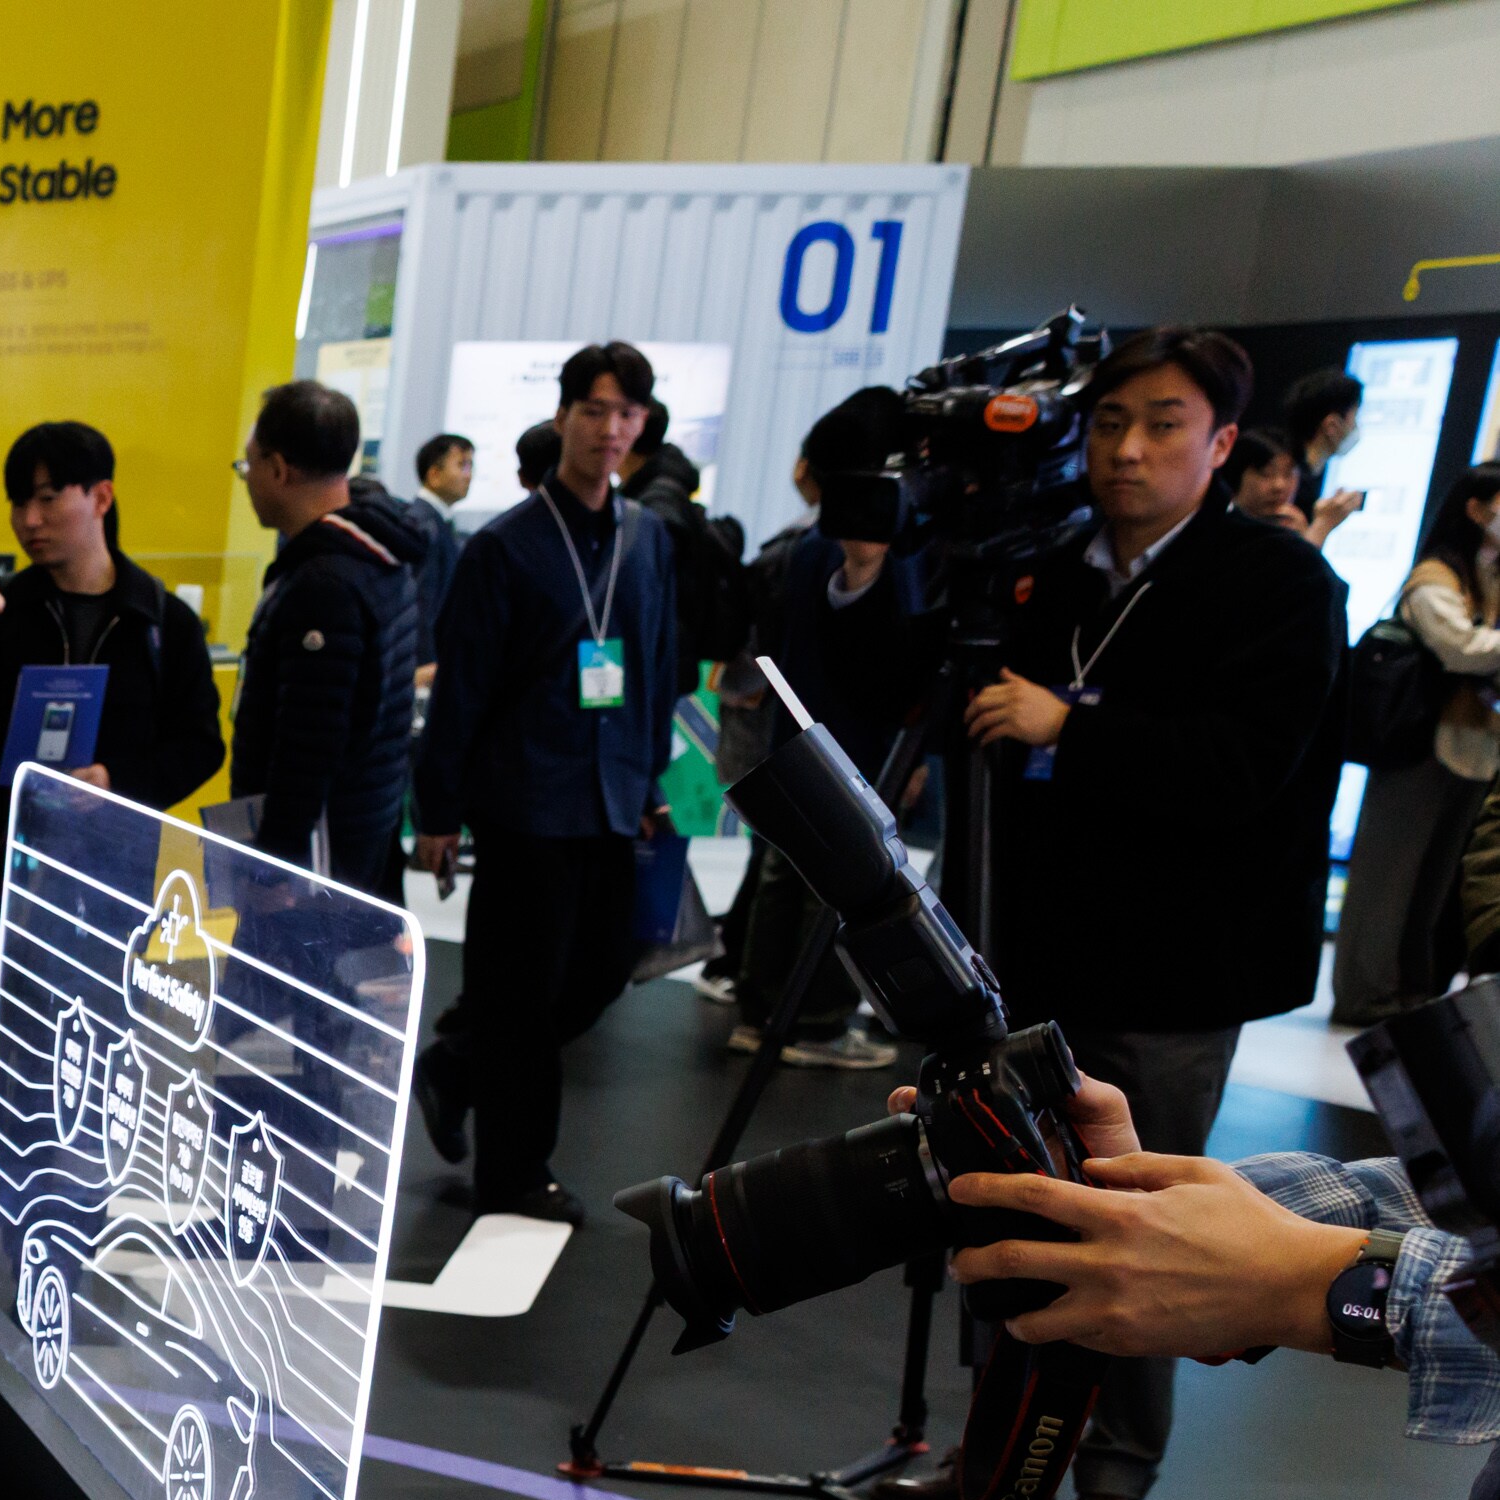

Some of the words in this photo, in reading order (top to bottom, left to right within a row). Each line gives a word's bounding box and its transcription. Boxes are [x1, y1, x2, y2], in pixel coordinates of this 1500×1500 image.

[1, 99, 99, 141] More
[778, 220, 904, 334] 01
[131, 957, 172, 1008] Perfect
[169, 975, 206, 1032] Safety
[1342, 1303, 1381, 1320] 10:50
